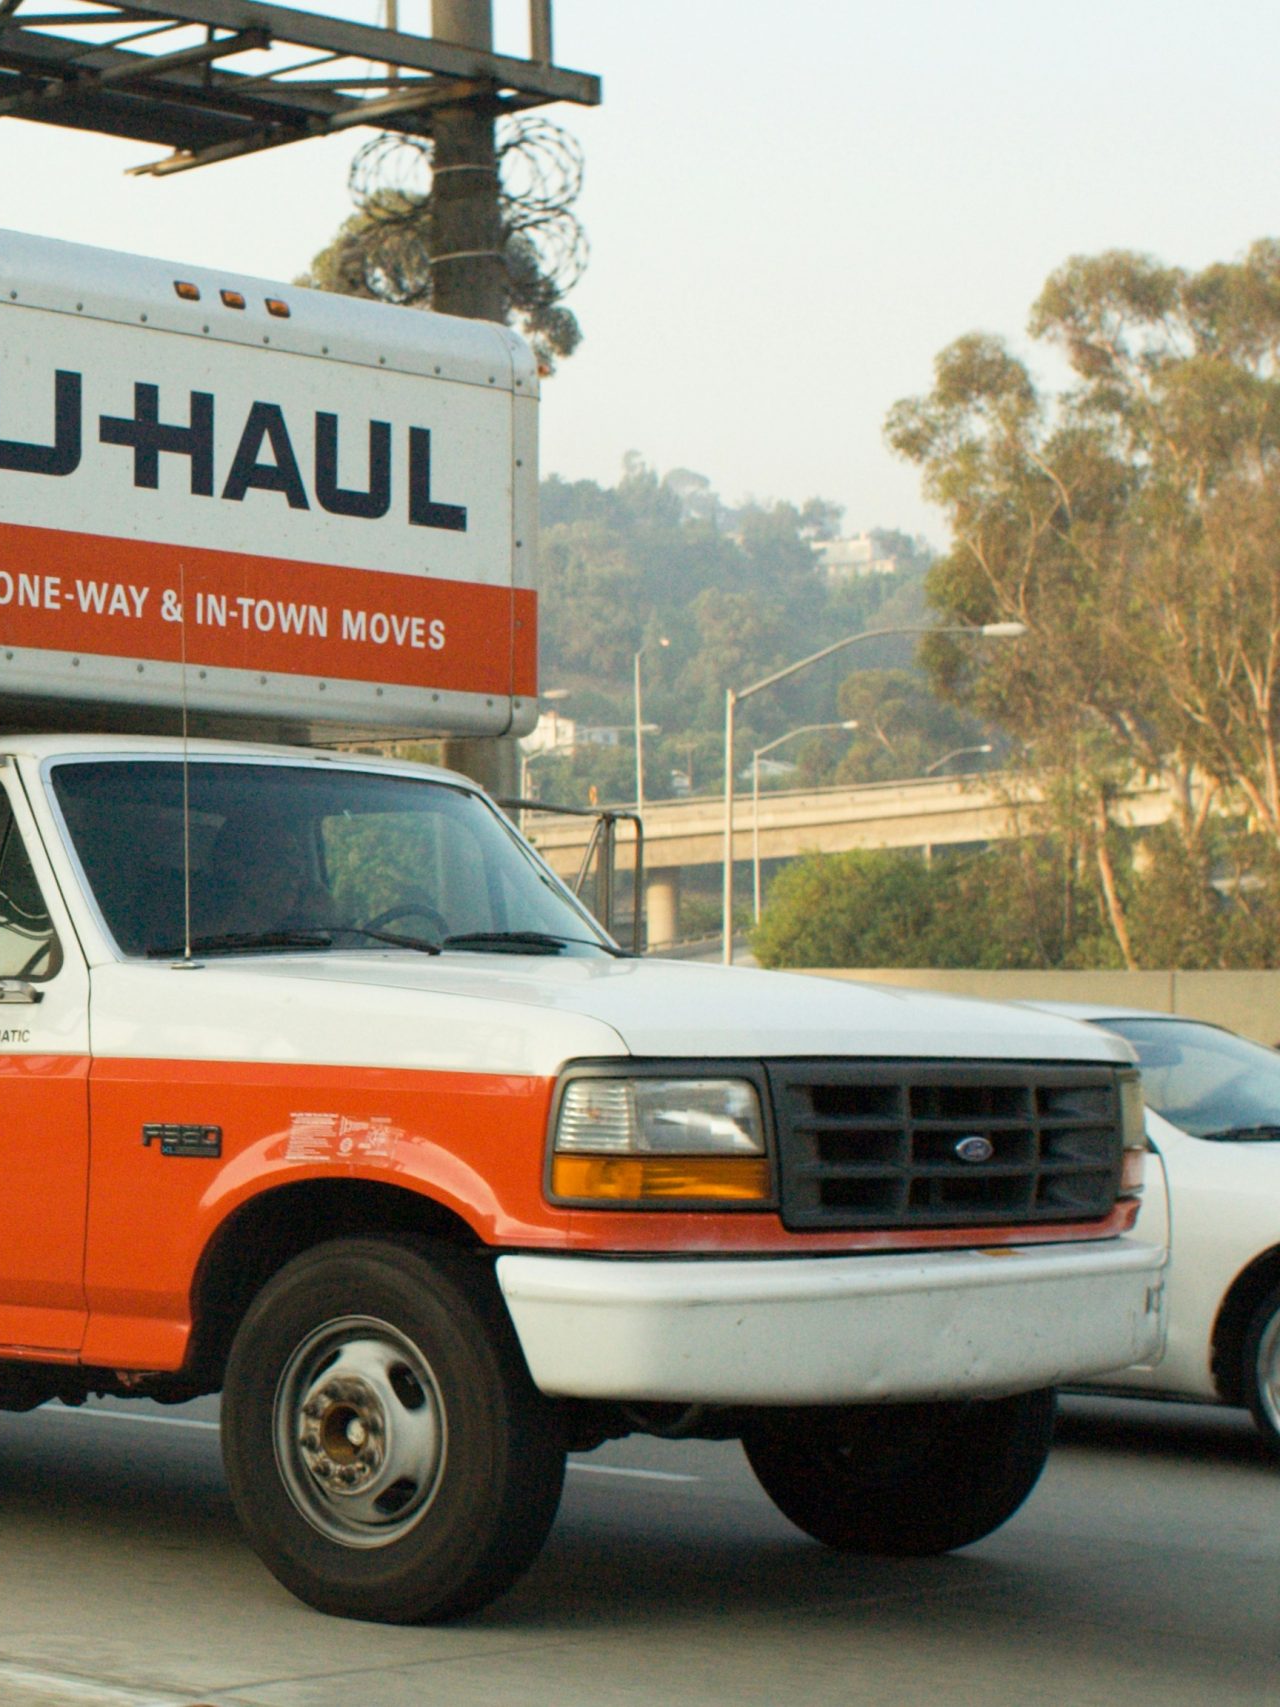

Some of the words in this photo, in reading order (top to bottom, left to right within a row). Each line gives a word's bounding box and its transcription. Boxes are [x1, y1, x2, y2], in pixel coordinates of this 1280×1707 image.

[161, 589, 184, 623] &
[195, 593, 328, 638] IN-TOWN
[342, 609, 446, 650] MOVES
